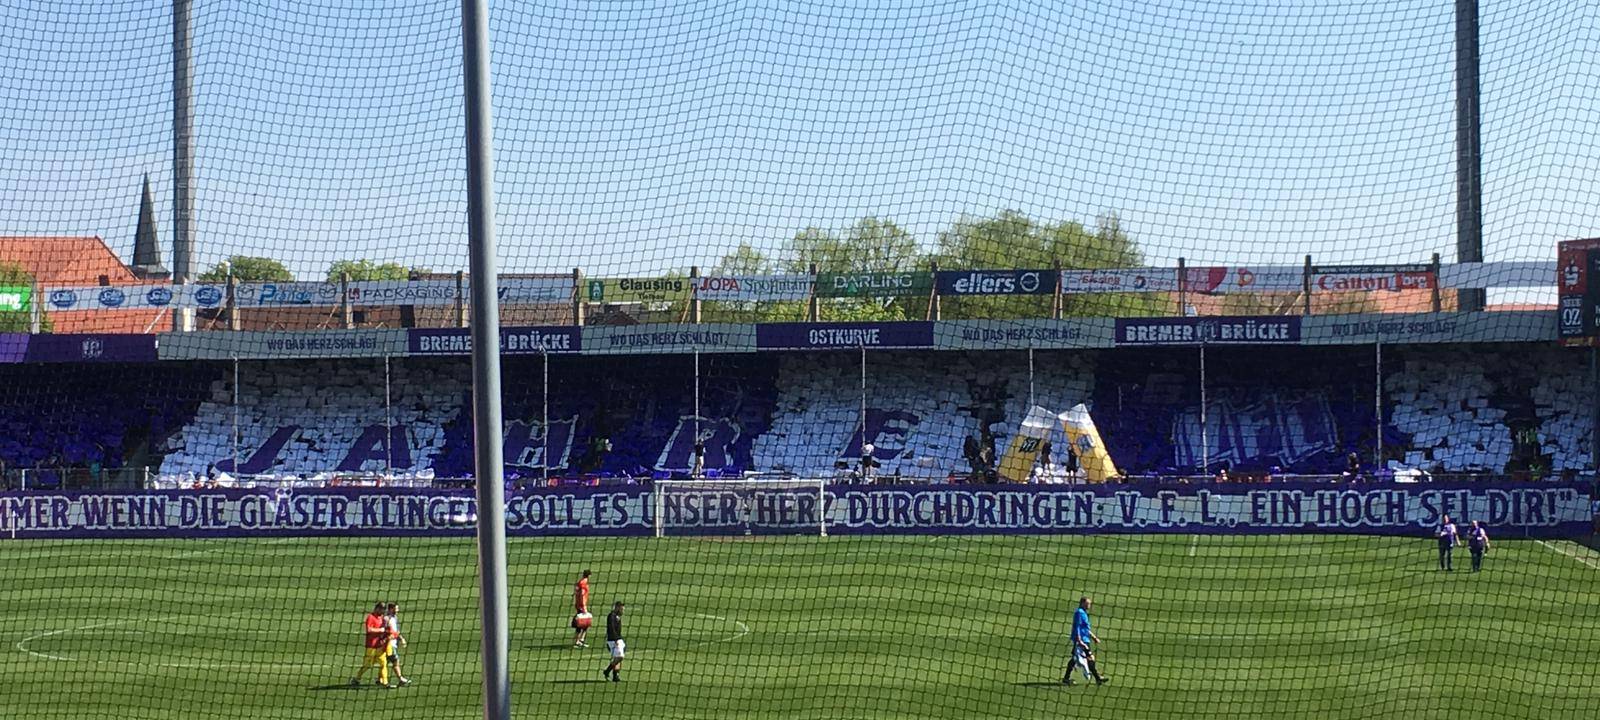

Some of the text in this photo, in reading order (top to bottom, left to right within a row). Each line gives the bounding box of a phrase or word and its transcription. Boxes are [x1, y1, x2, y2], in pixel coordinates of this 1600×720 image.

[619, 278, 682, 292] Clausing
[699, 277, 740, 292] JOPA
[833, 275, 913, 289] DARLING
[952, 272, 1016, 293] ellers
[363, 287, 455, 299] PACKAGING
[1563, 308, 1581, 326] OZ
[809, 328, 880, 345] OSTKURVE
[1126, 324, 1193, 341] BREMER
[1221, 320, 1289, 339] BRÜCKE
[508, 331, 570, 350] BRÜCKE
[81, 496, 168, 529] WENN
[180, 496, 228, 529] DIE
[240, 487, 349, 529] GLÄSER
[507, 495, 583, 529] SOLL
[592, 494, 629, 528] ES
[639, 492, 741, 527] UNSER
[755, 492, 836, 527] HERZ
[1248, 490, 1304, 527] EIN
[1314, 490, 1409, 527] HOCH
[1418, 489, 1471, 526] SEI
